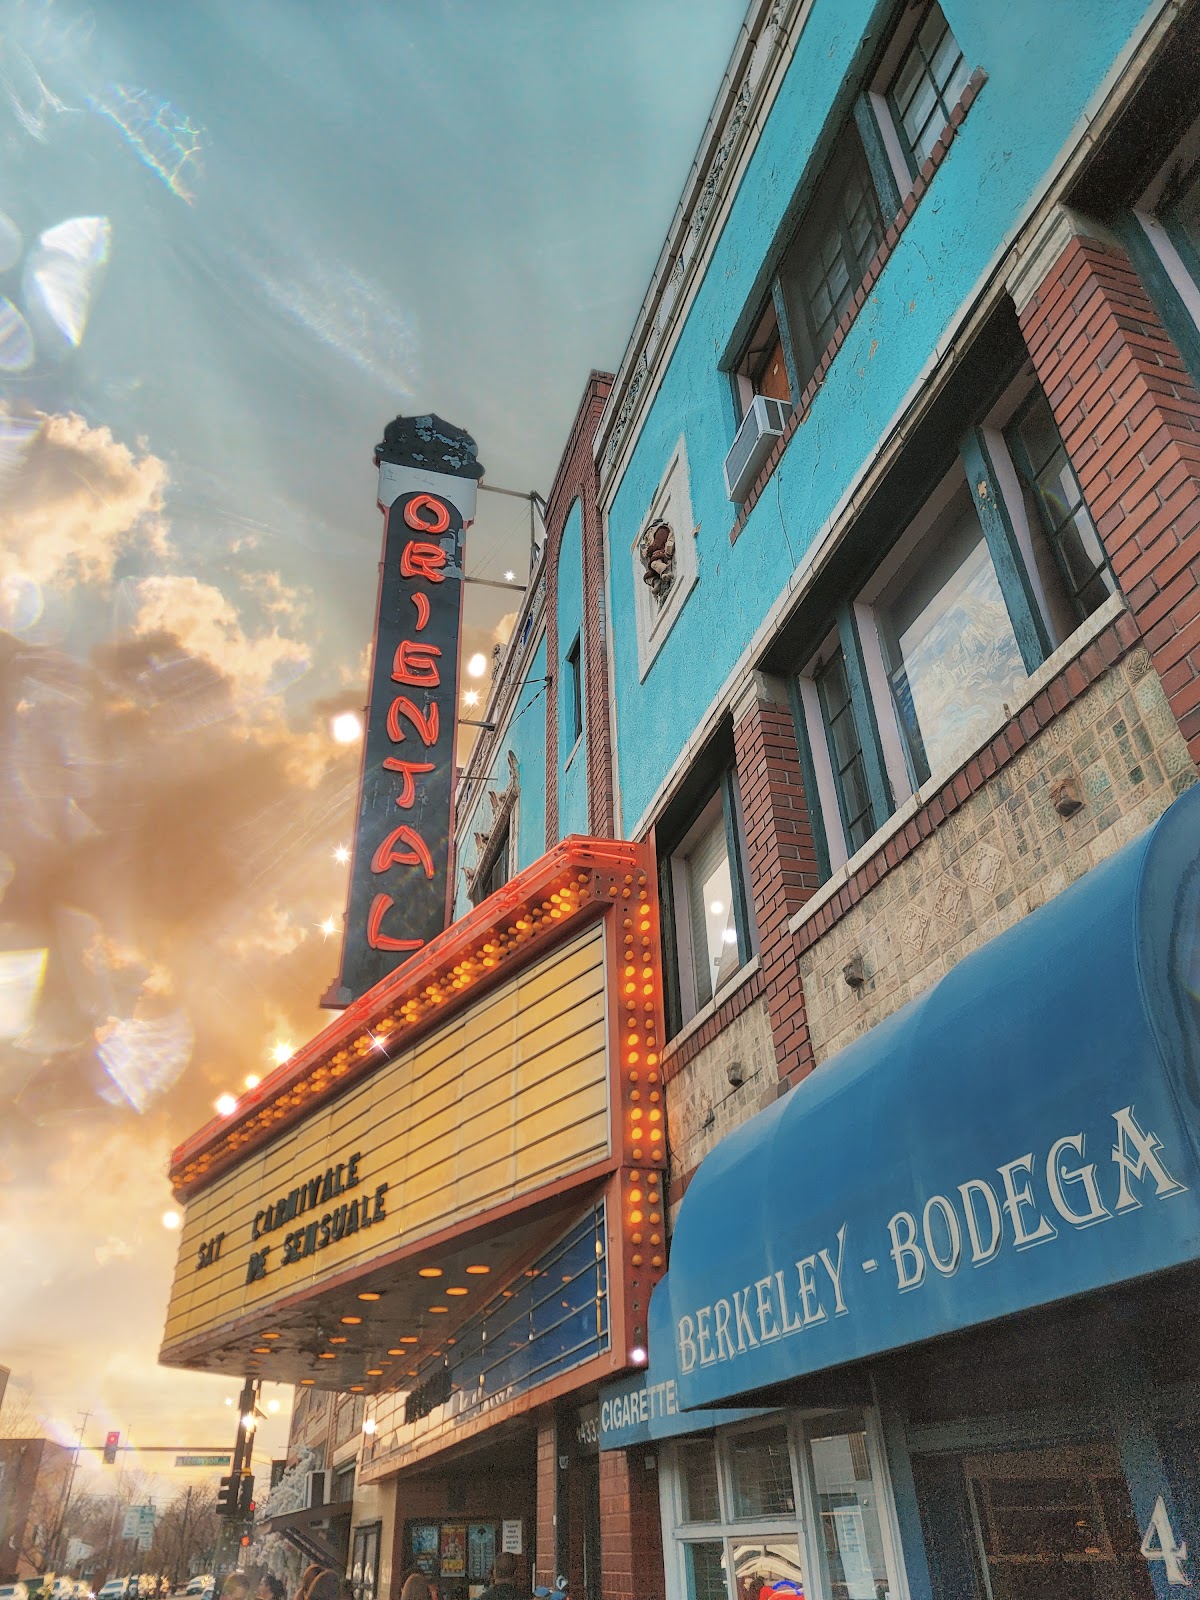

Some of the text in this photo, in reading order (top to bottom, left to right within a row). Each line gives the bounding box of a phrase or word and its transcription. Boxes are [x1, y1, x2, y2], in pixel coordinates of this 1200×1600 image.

[367, 494, 452, 951] ORIENTAL
[251, 1151, 362, 1242] CARNIVALE
[280, 1181, 389, 1266] SENSUALE
[678, 1222, 851, 1376] BERKELEY
[886, 1104, 1190, 1295] BODEGA
[1140, 1495, 1193, 1586] 4
